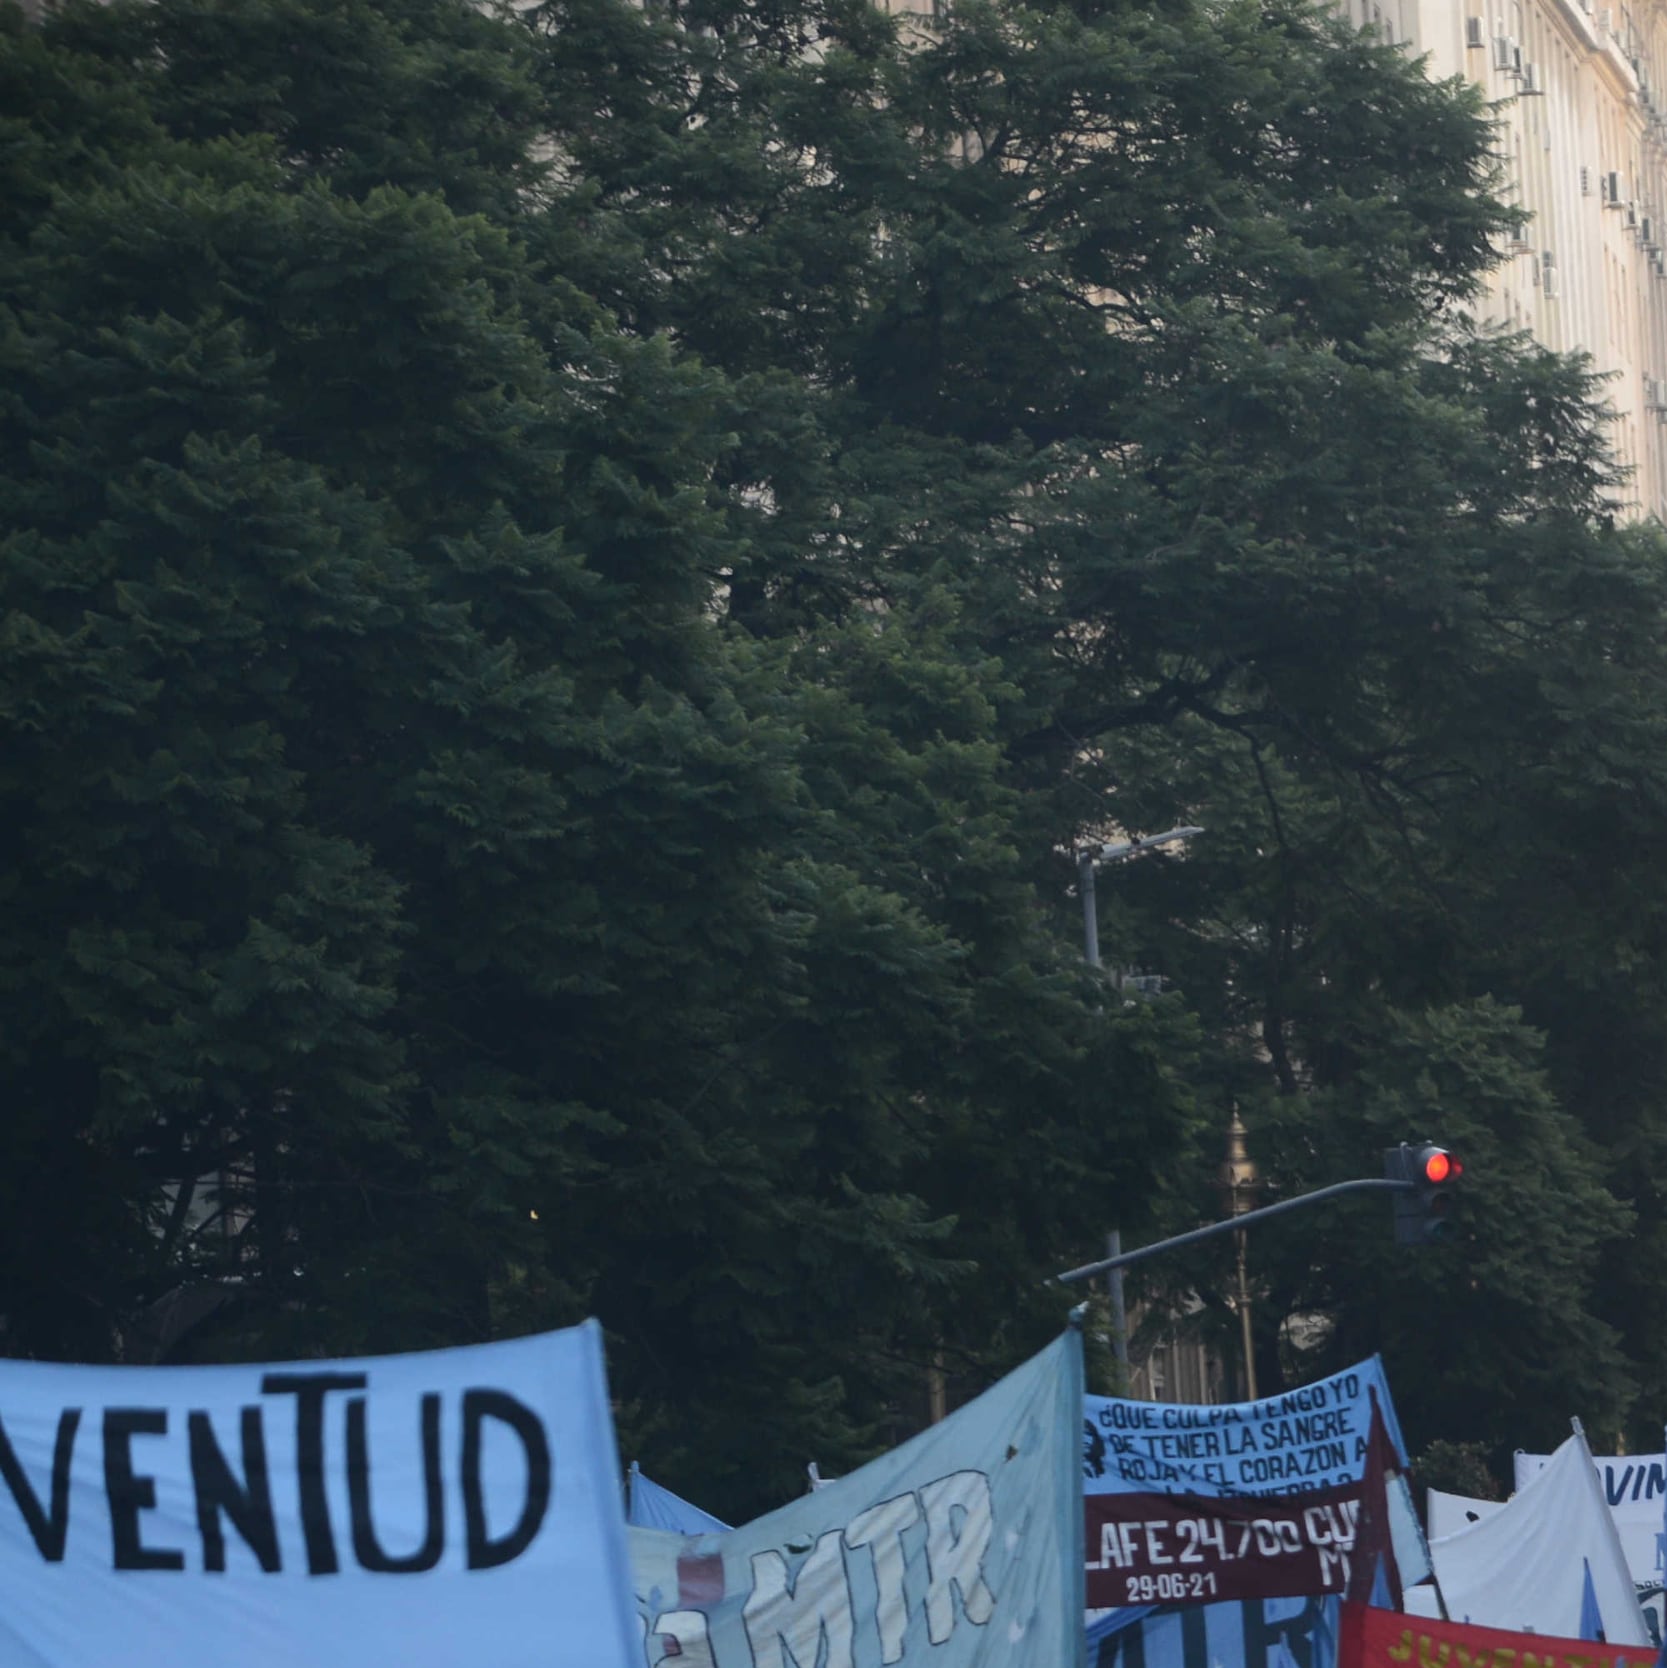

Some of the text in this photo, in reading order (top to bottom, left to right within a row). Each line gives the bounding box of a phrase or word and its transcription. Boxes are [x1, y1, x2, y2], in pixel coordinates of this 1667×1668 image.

[1163, 1406, 1243, 1430] CULPA
[1328, 1373, 1360, 1407] YO
[1140, 1431, 1220, 1460] TENER
[1223, 1421, 1258, 1455] LA
[1264, 1408, 1356, 1452] SANGRE
[1117, 1457, 1181, 1482] ROJA
[1239, 1441, 1345, 1485] CORAZON
[1175, 1514, 1303, 1565] 24.700
[1126, 1572, 1218, 1602] 29-06-21
